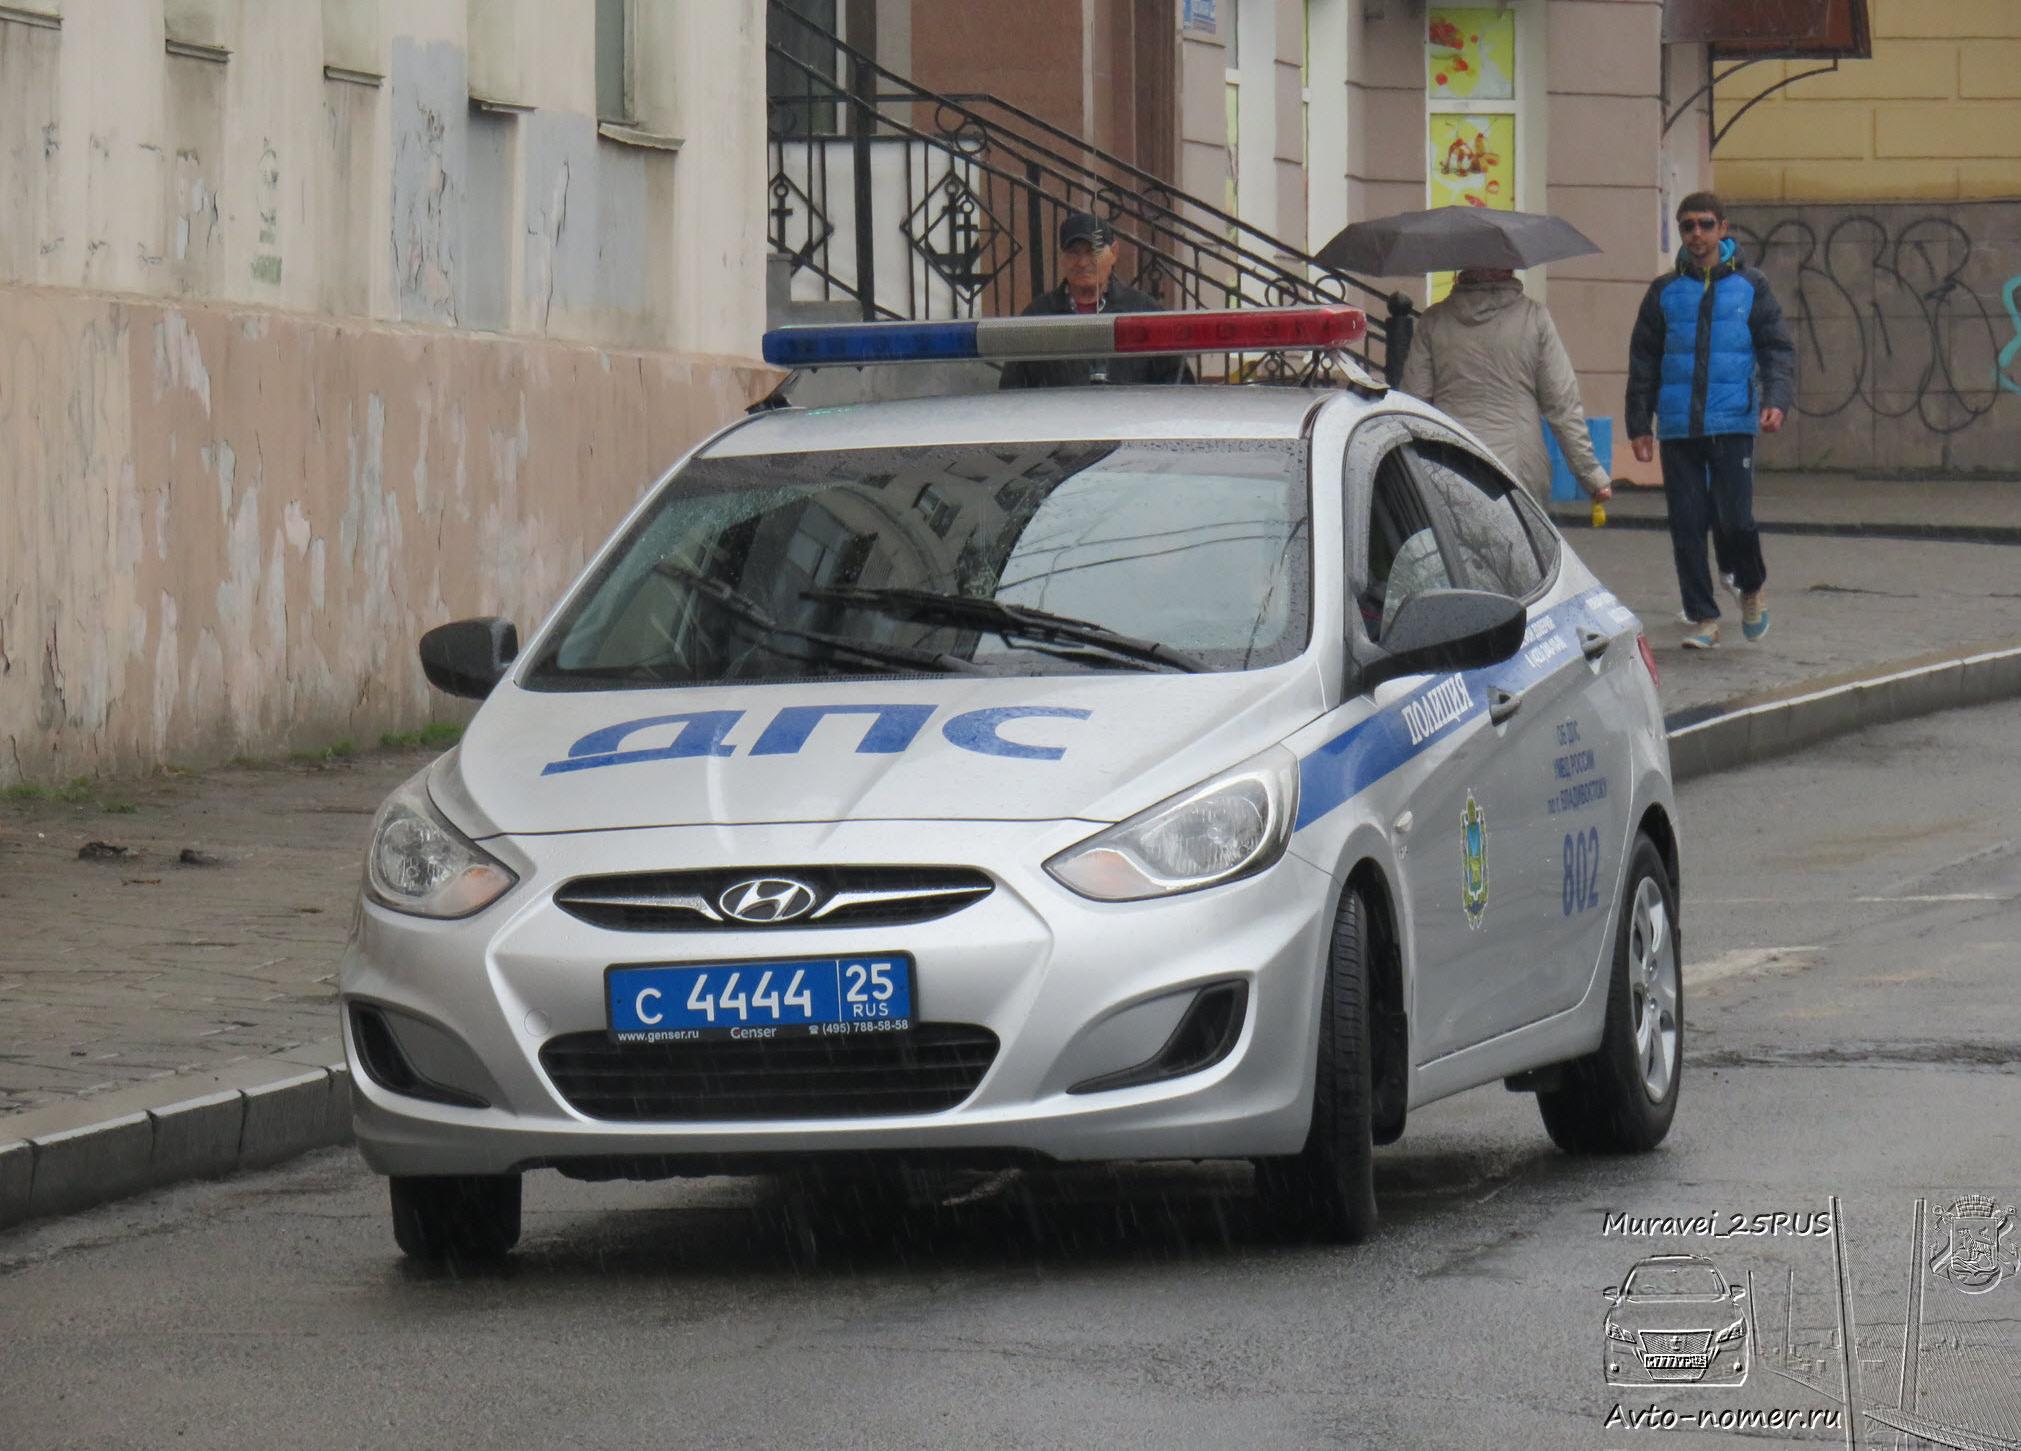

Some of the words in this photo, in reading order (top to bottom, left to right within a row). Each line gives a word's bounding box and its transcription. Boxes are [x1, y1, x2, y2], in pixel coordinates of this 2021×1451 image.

[1401, 672, 1474, 745] ПОЛИЦИЯ
[540, 704, 1094, 776] ДПС
[1562, 826, 1599, 917] 802
[688, 970, 812, 1021] 4444
[845, 963, 894, 1002] 25
[853, 1002, 889, 1017] RUS
[618, 1029, 699, 1043] www.genser.ru
[730, 1027, 777, 1039] Genser
[822, 1023, 850, 1036] (495)
[853, 1020, 909, 1033] 788-58-58
